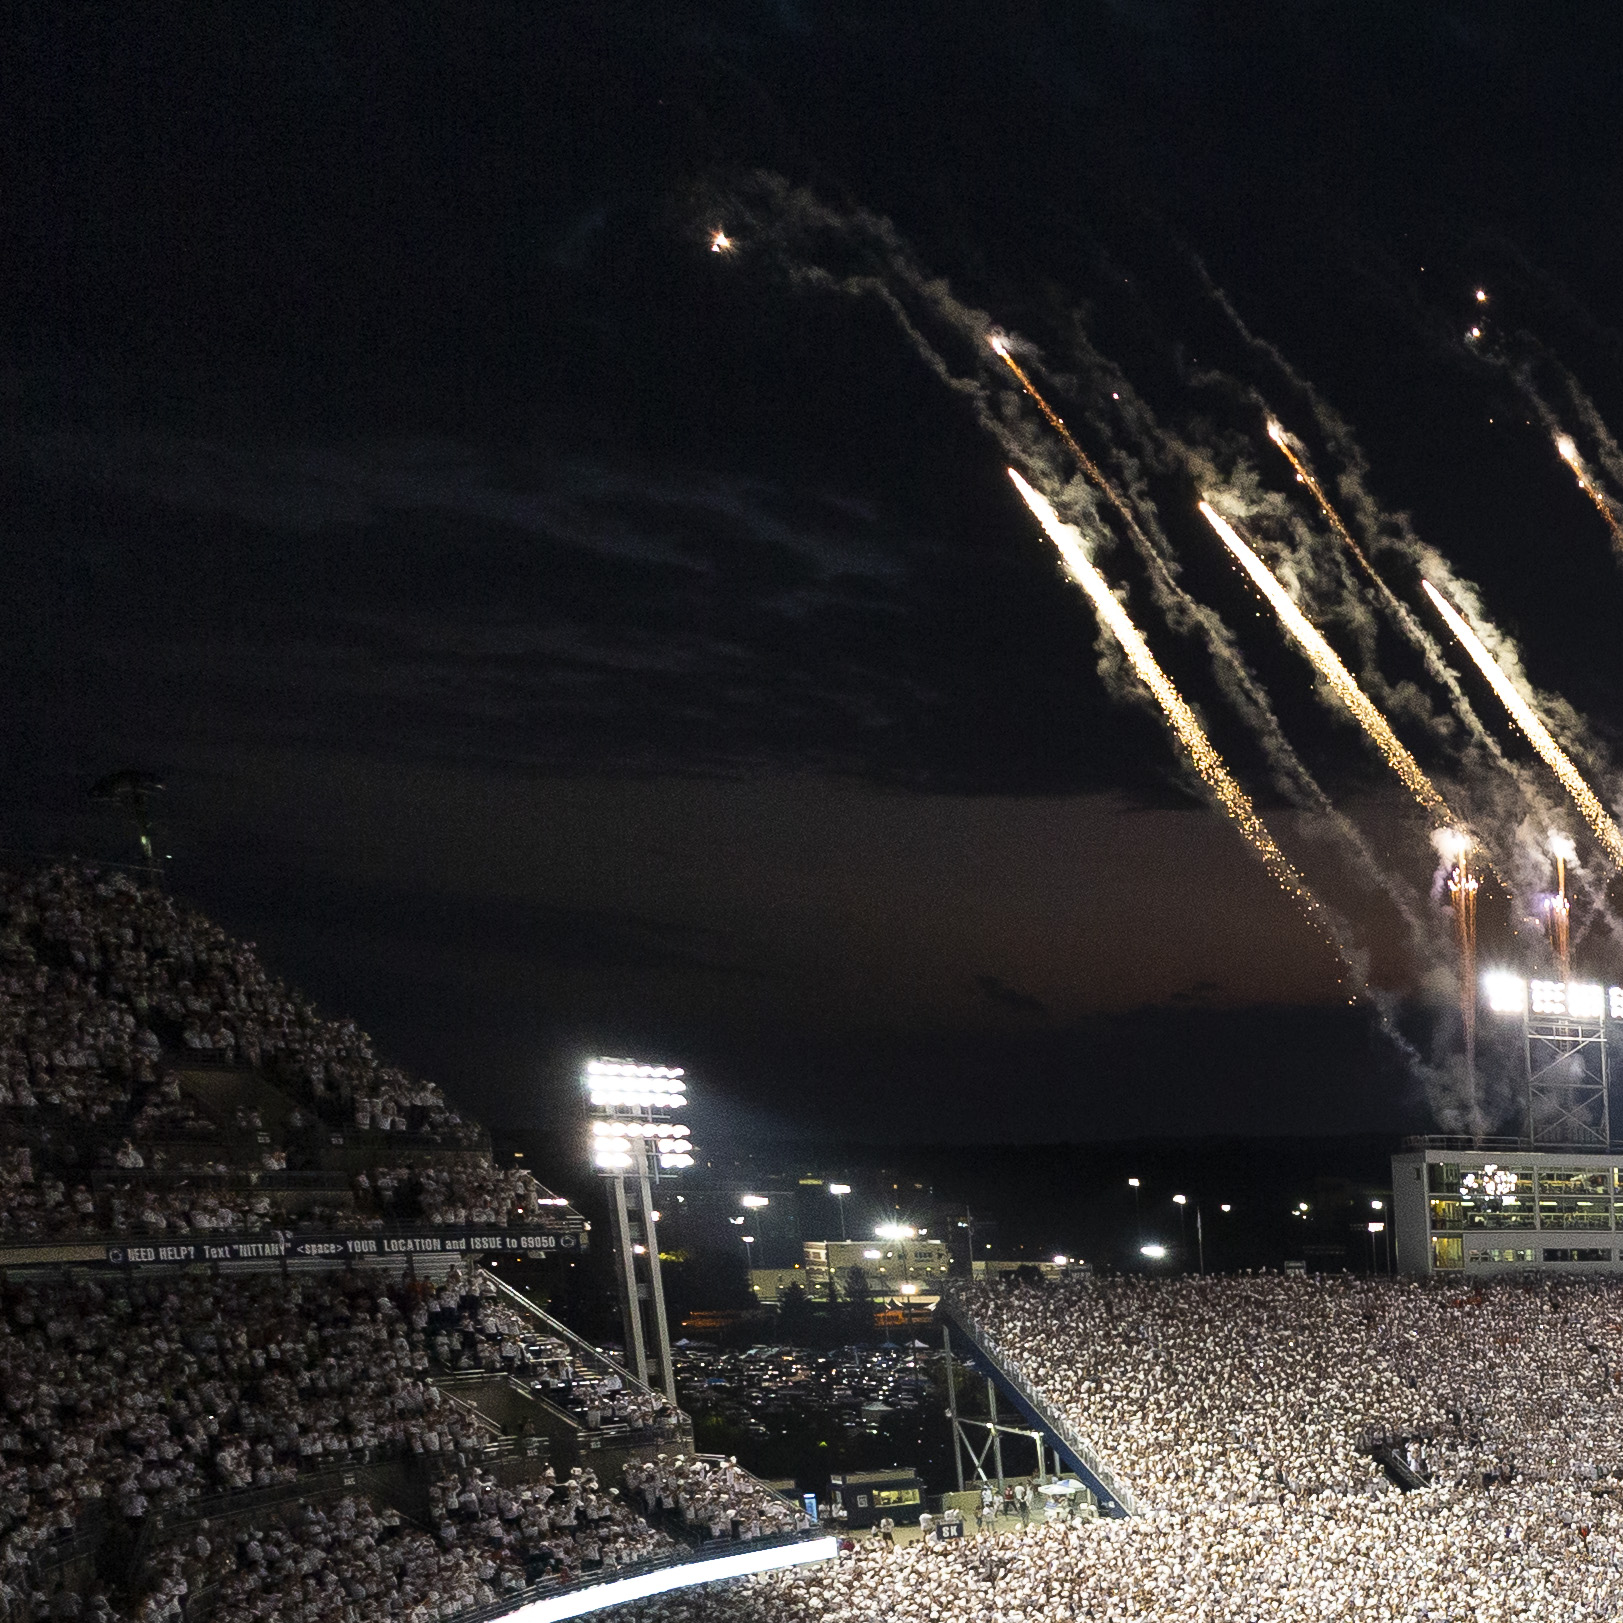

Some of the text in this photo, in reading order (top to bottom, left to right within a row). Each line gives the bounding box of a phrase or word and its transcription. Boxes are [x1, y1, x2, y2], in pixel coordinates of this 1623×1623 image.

[128, 1248, 155, 1261] NEED
[159, 1247, 195, 1260] HELP?
[204, 1245, 230, 1258] Text
[297, 1243, 343, 1256] <space>
[347, 1241, 377, 1252] YOUR
[384, 1239, 441, 1251] LOCATION
[445, 1239, 466, 1249] and
[471, 1237, 502, 1249] ISSUE
[506, 1238, 517, 1248] to
[942, 1525, 958, 1538] SK
